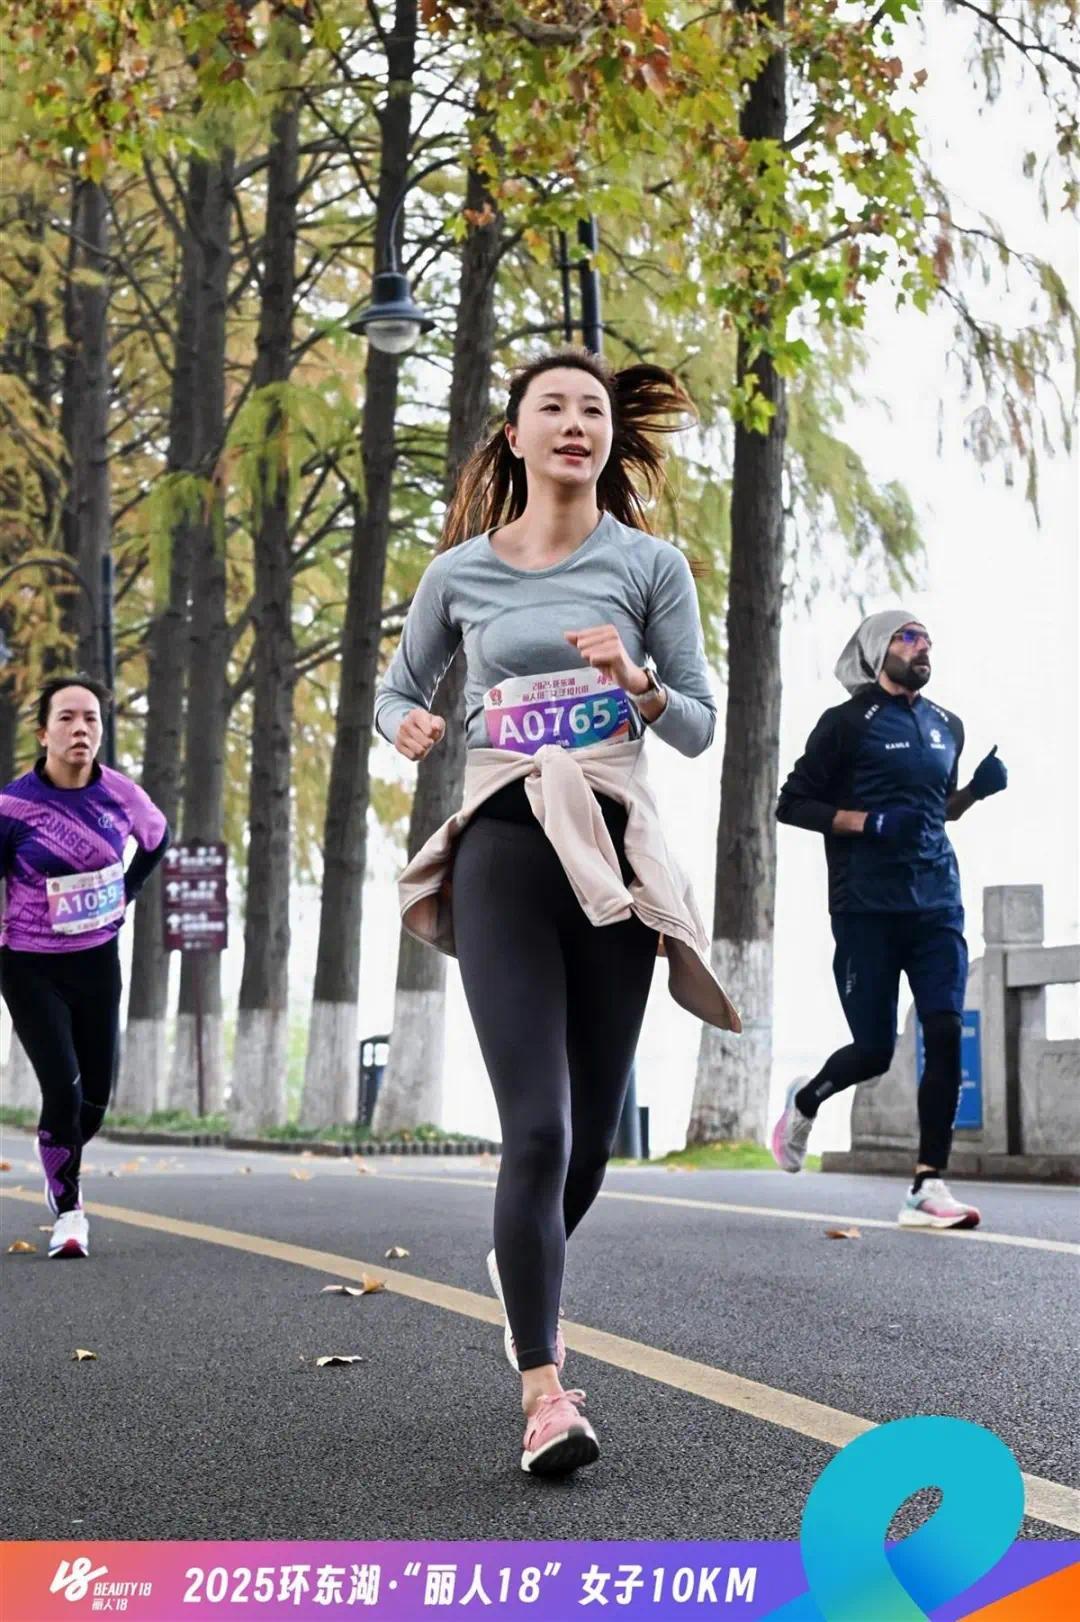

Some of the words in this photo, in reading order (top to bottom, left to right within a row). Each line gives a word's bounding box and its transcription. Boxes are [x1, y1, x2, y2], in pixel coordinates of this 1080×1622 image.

[499, 699, 611, 746] A0765
[35, 812, 100, 861] SUNSET
[55, 886, 118, 917] A1059
